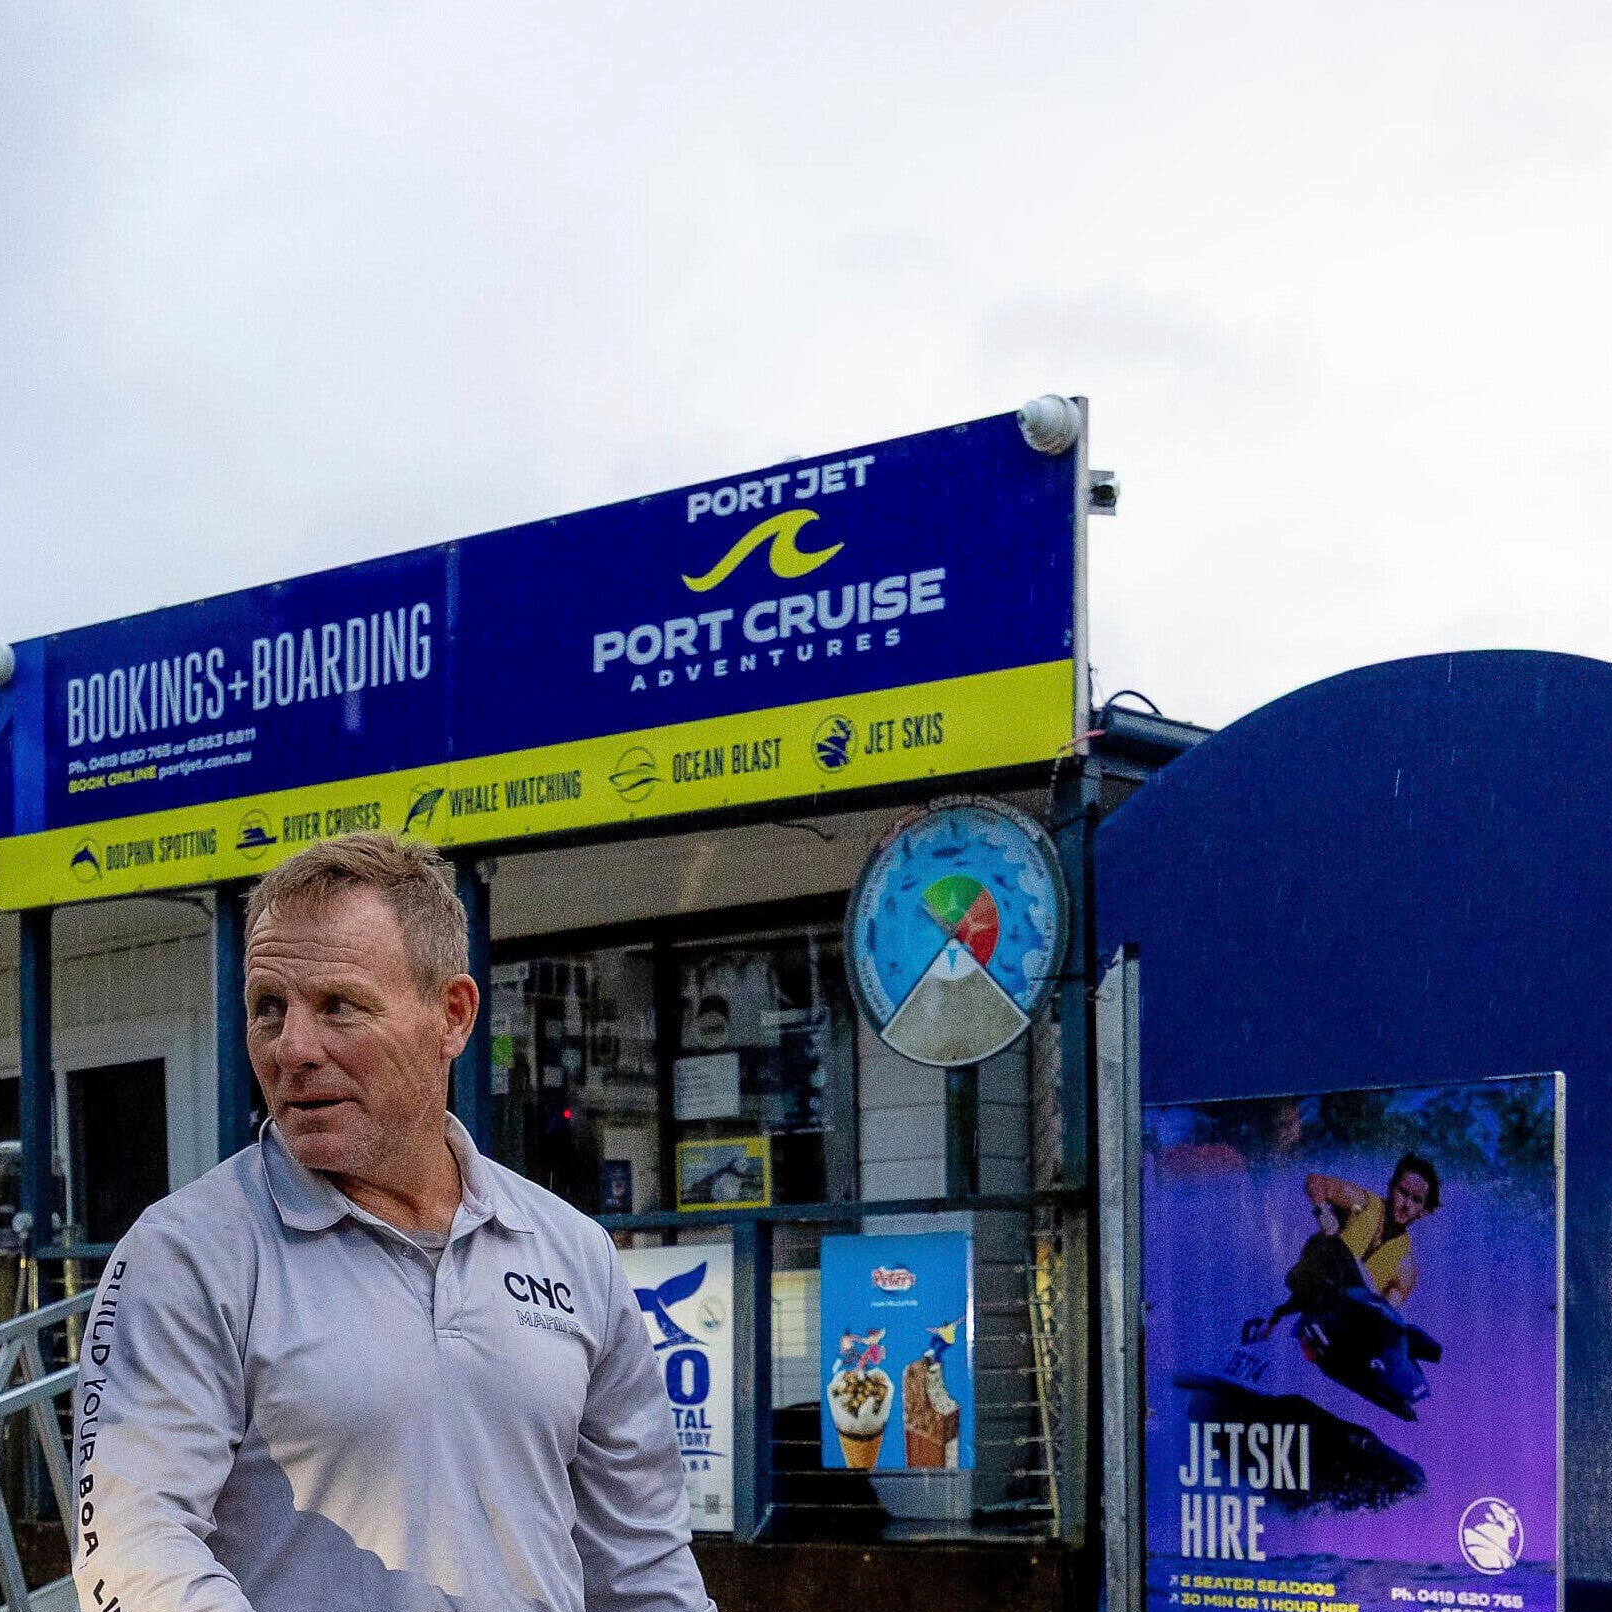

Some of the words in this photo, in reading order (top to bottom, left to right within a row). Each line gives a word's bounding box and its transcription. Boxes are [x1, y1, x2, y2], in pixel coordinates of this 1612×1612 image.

[688, 474, 789, 523] PORT
[795, 456, 875, 499] JET
[593, 609, 734, 673] PORT
[743, 567, 946, 643] CRUISE
[631, 628, 900, 691] ADVENTURES
[864, 721, 895, 756] JET
[902, 712, 944, 748] SKIS
[68, 775, 106, 794] BOOK
[108, 765, 157, 786] ONLINE
[672, 746, 724, 783] OCEAN
[733, 737, 782, 775] BLAST
[450, 783, 498, 817] WHALE
[505, 770, 581, 809] WATCHING
[283, 811, 320, 843] RIVER
[325, 802, 380, 838] CRUISES
[106, 840, 154, 870] DOLPHIN
[159, 828, 217, 862] SPOTTING
[504, 1272, 574, 1314] CNC
[80, 1378, 107, 1466] YOUR
[1179, 1422, 1310, 1491] JETSKI
[1181, 1493, 1266, 1562] HIRE
[1181, 1592, 1201, 1606] 30
[1203, 1595, 1234, 1608] MIN
[1236, 1597, 1259, 1609] OR
[1262, 1598, 1269, 1610] 1
[1193, 1575, 1254, 1591] SEATER
[1257, 1578, 1336, 1597] SEADOOS
[1391, 1587, 1415, 1601] Ph.
